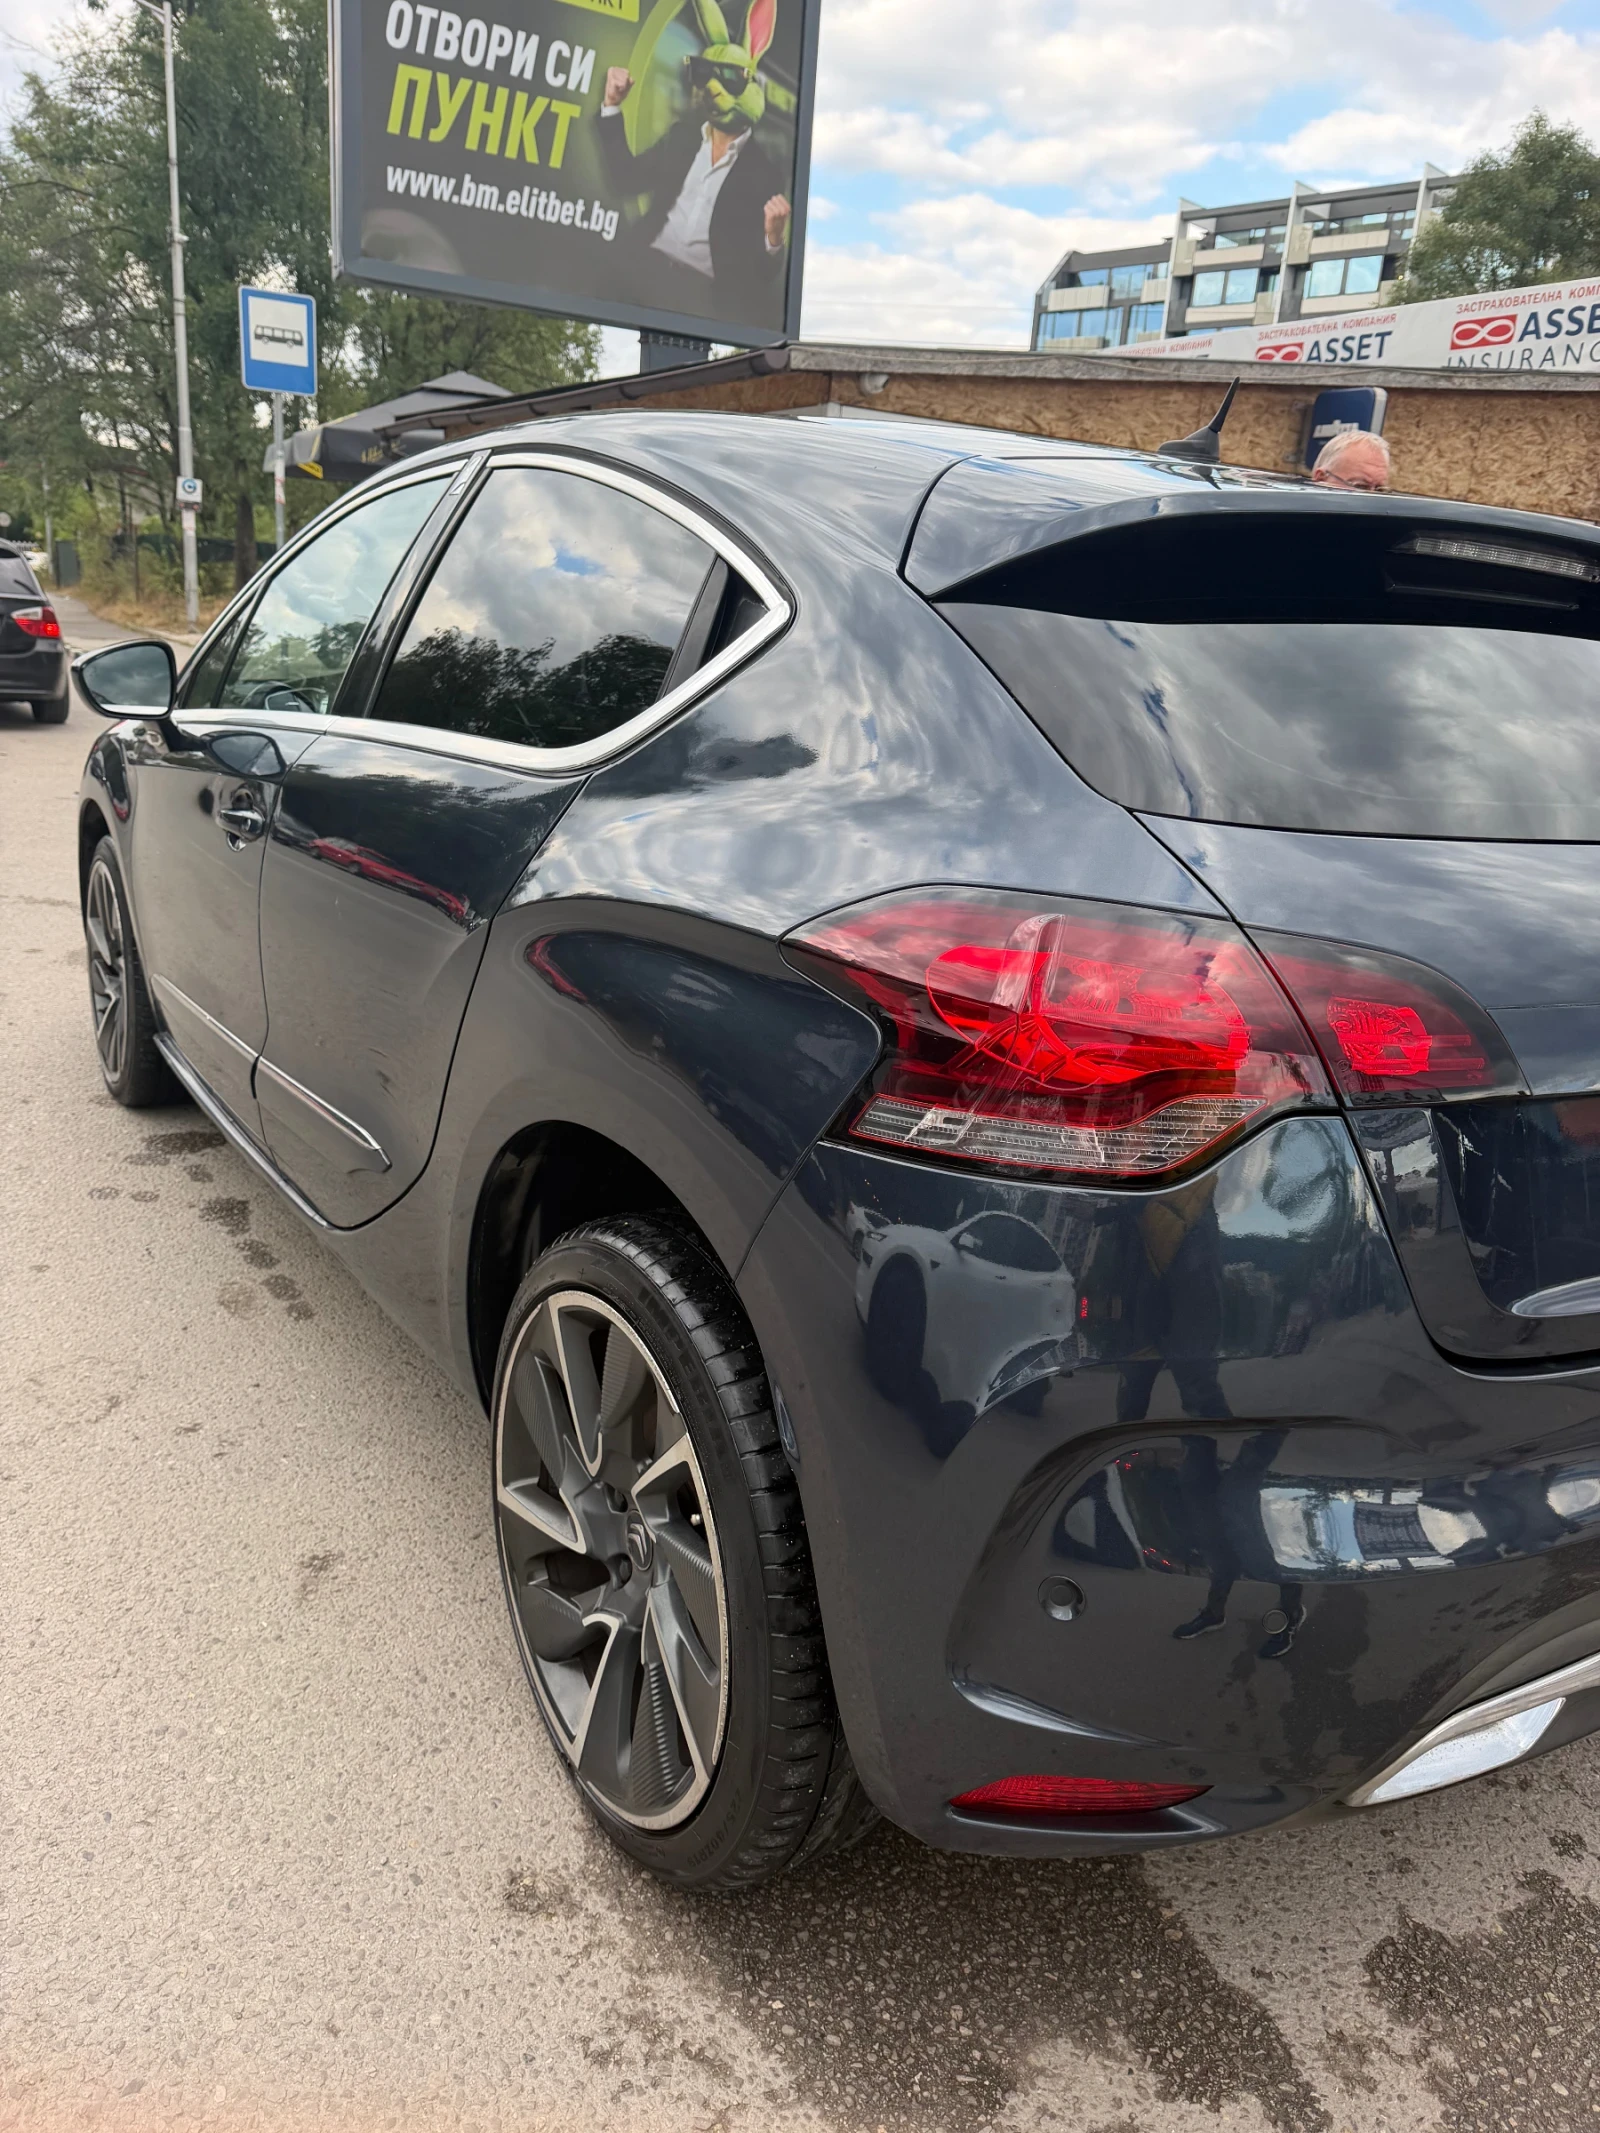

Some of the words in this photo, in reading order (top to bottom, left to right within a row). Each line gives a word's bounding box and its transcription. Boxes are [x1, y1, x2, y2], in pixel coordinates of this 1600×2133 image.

[385, 0, 540, 81] ОТВОРИ
[545, 40, 596, 94] СИ
[386, 63, 582, 169] ПУНКТ
[386, 165, 620, 242] www.bm.elitbet.bg
[1341, 312, 1397, 331] КОМПАНИЯ
[1456, 289, 1562, 315] ЗАСТРАХОВАТЕЛНА
[1306, 330, 1393, 363] ASSET
